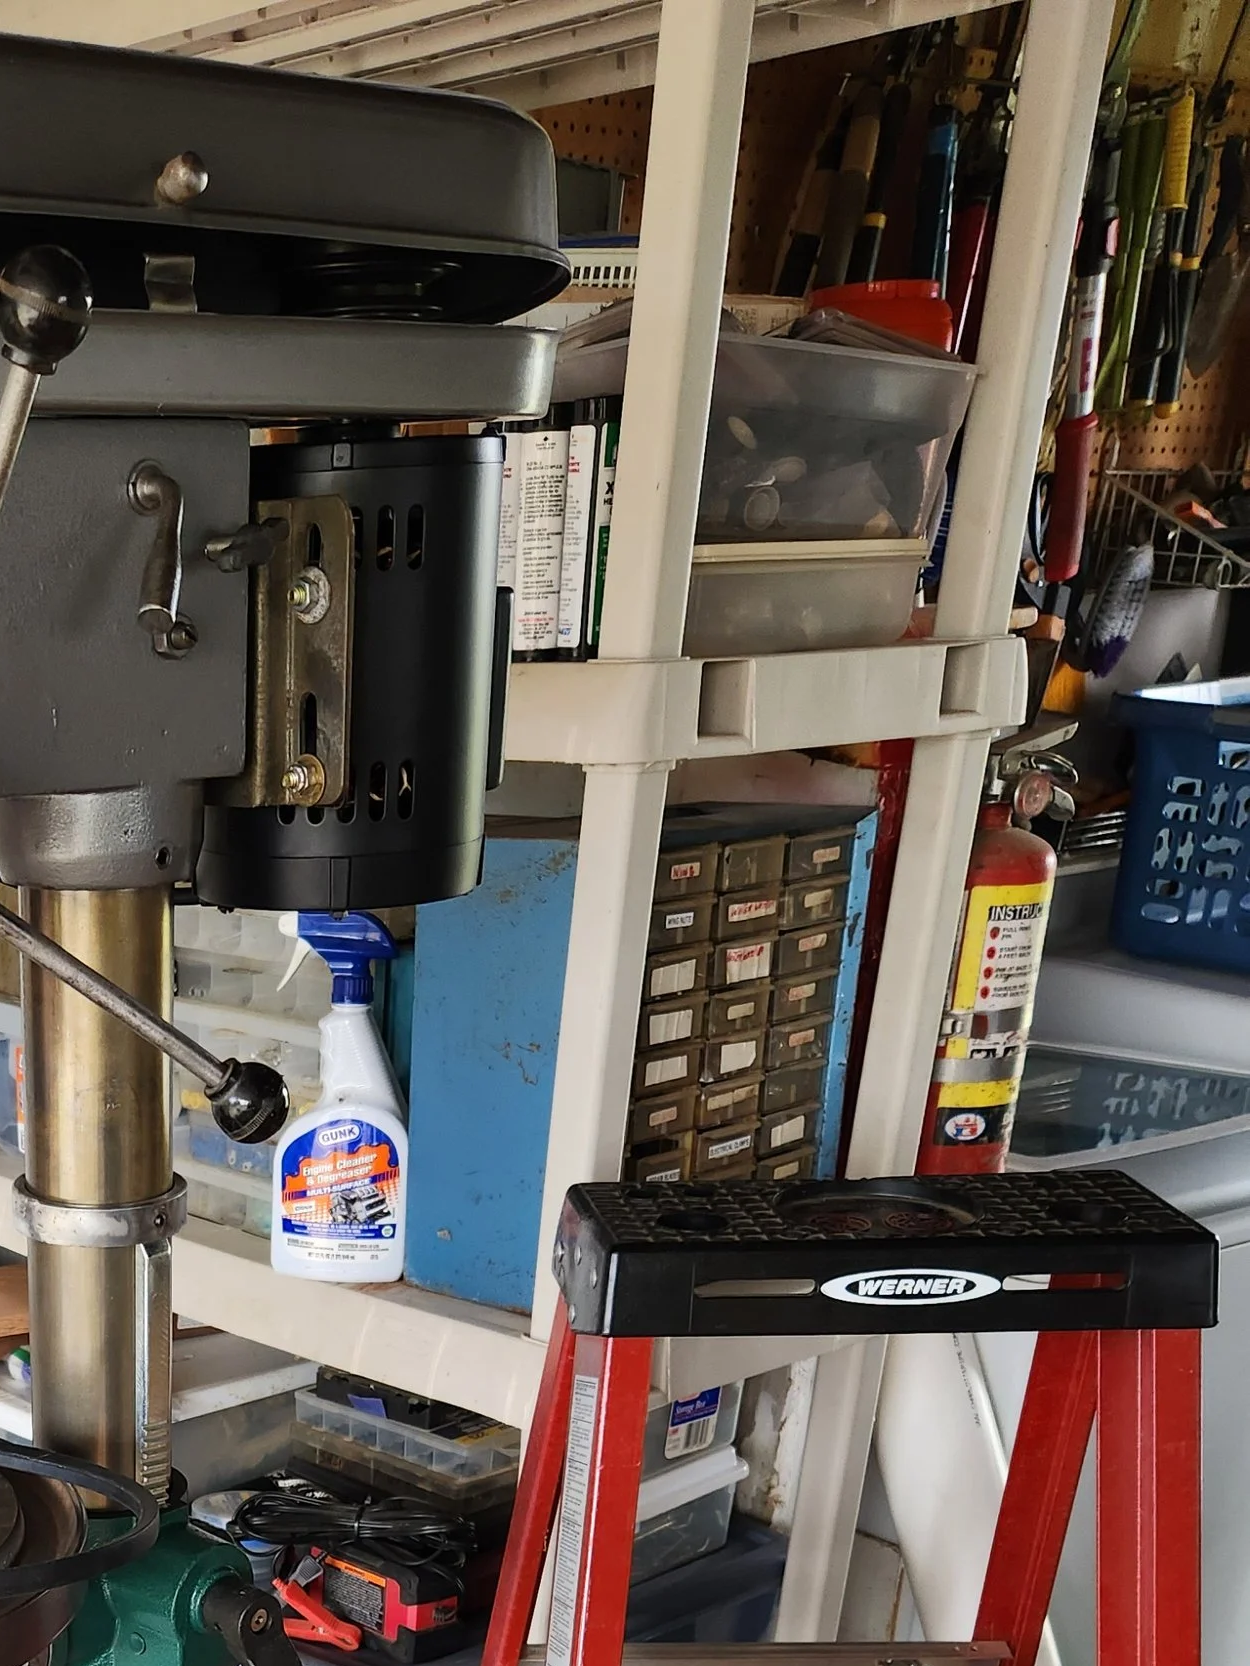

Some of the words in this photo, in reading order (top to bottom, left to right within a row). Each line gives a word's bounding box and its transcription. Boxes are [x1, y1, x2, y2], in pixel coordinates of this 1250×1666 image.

[321, 1127, 357, 1143] GUNK
[302, 1163, 334, 1177] Engine
[336, 1153, 377, 1170] Cleaner
[306, 1176, 315, 1186] &
[317, 1165, 373, 1184] Degreaser
[306, 1178, 371, 1197] MULTI-SURFACE
[858, 1277, 968, 1297] WERNER
